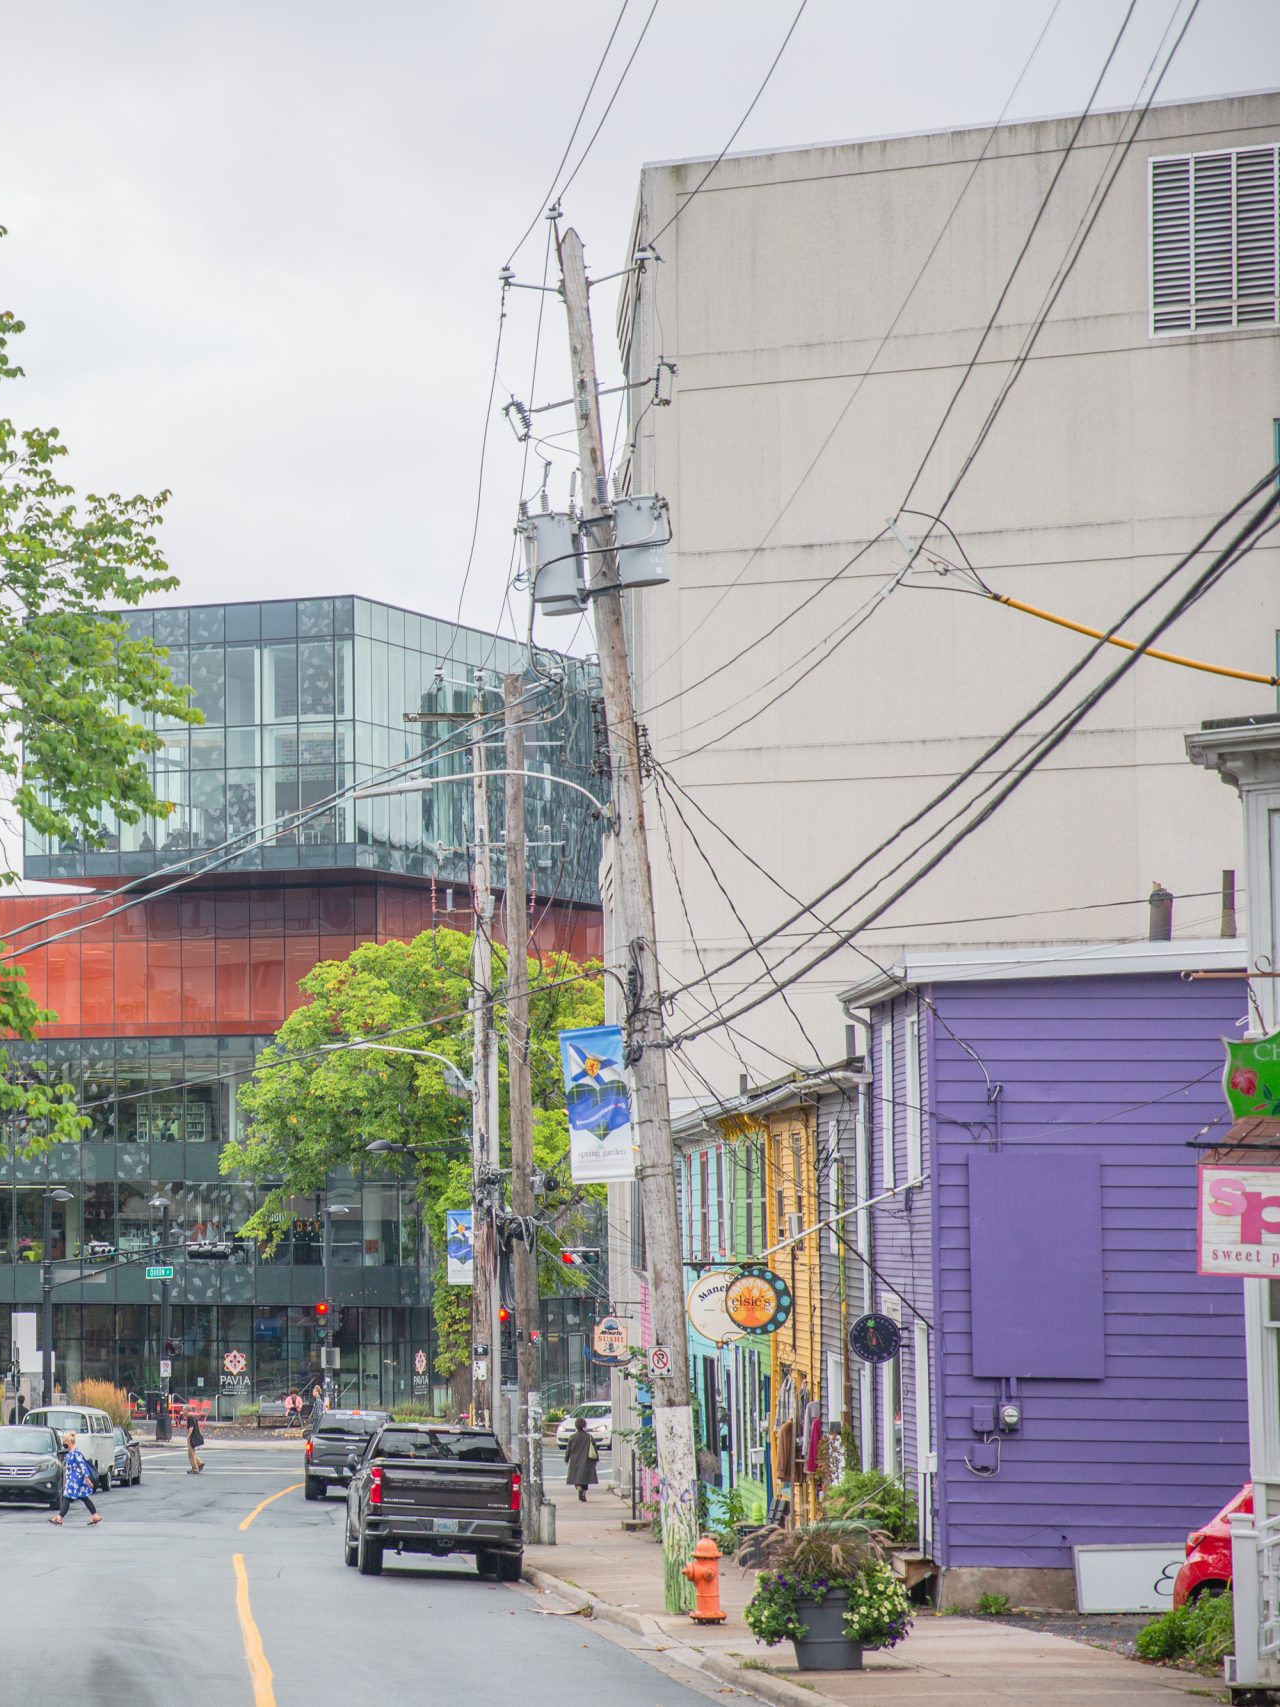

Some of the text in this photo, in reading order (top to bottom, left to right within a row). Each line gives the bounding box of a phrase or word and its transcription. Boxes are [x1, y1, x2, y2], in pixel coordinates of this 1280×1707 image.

[1212, 1248, 1261, 1262] sweet
[598, 1335, 624, 1343] SUSHI
[220, 1375, 251, 1386] PAVIA
